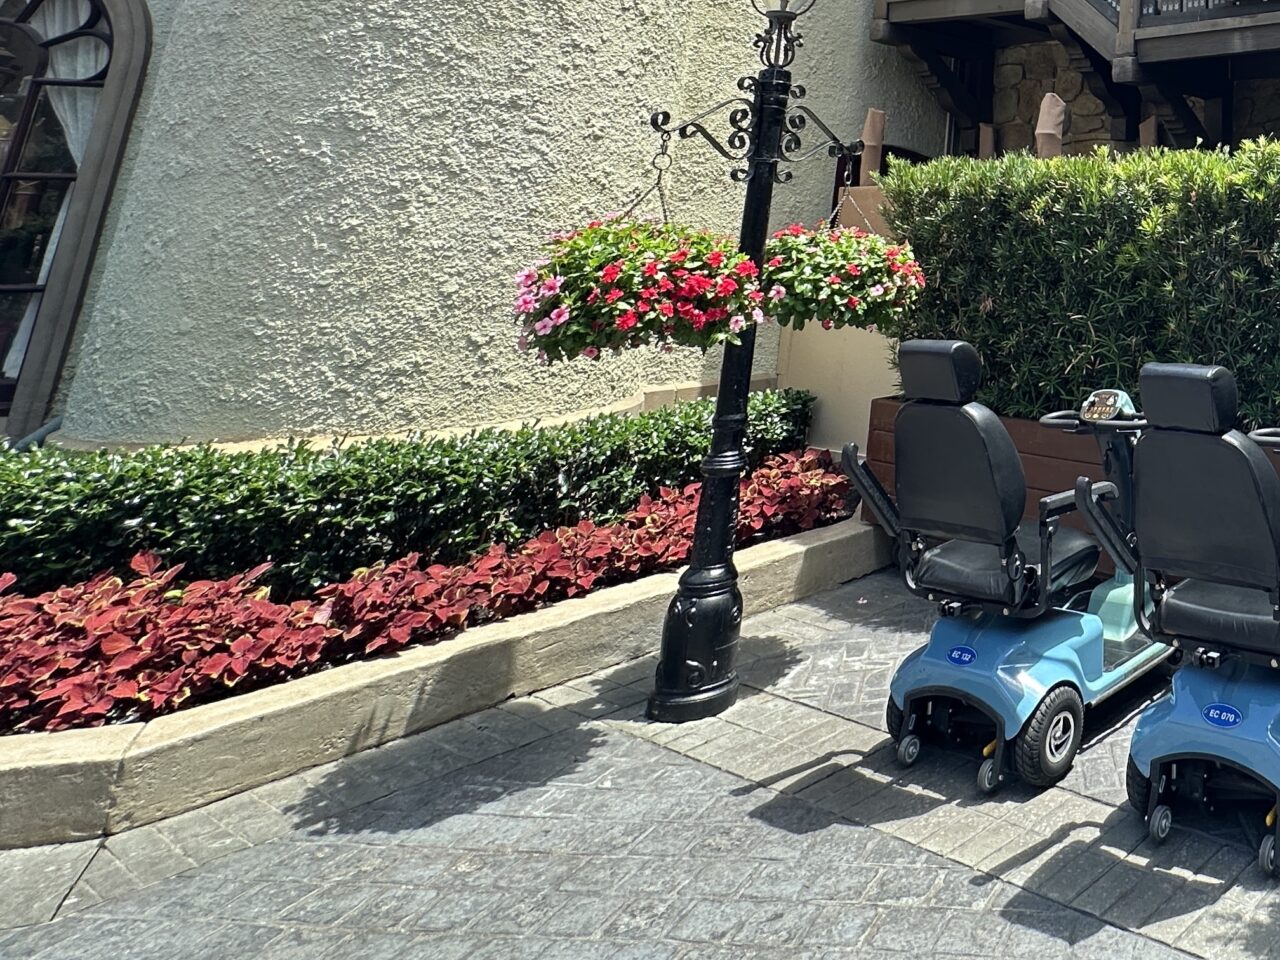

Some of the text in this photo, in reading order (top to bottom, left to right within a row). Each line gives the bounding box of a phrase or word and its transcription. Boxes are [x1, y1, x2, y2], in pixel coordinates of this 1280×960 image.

[952, 650, 961, 658] EC
[1209, 709, 1235, 722] EC 070
